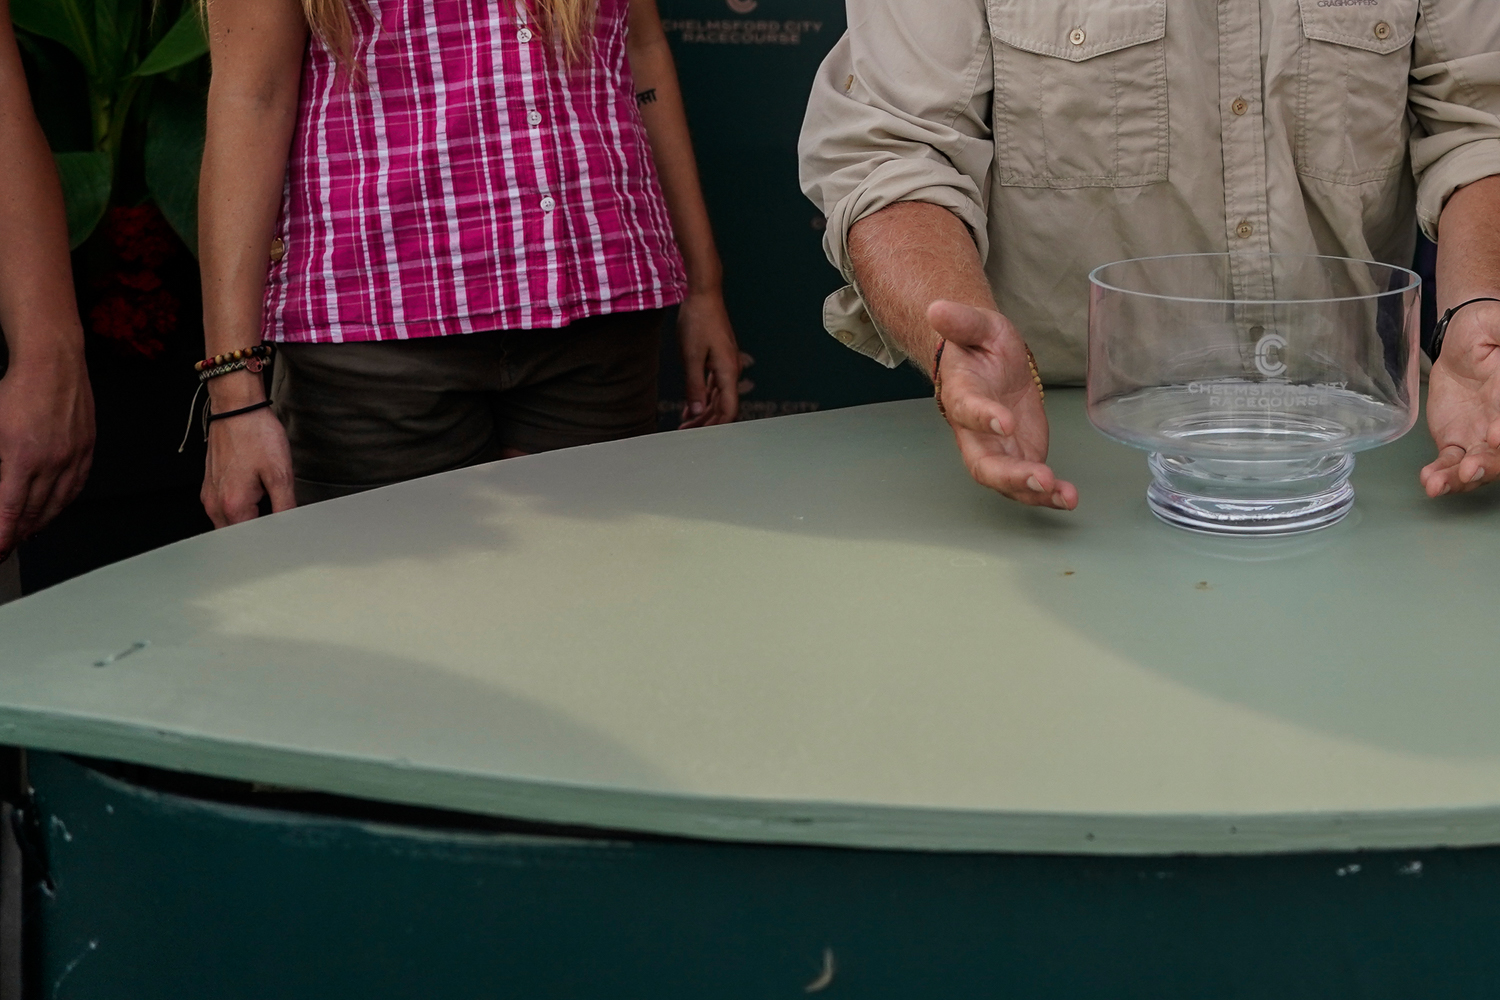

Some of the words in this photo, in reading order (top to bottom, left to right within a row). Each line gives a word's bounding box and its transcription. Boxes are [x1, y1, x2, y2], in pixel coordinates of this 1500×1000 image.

[784, 21, 823, 32] CITY
[682, 32, 800, 45] RACECOURSE
[1188, 382, 1308, 396] CHELMSFORD
[1209, 396, 1329, 408] RACECOURSE
